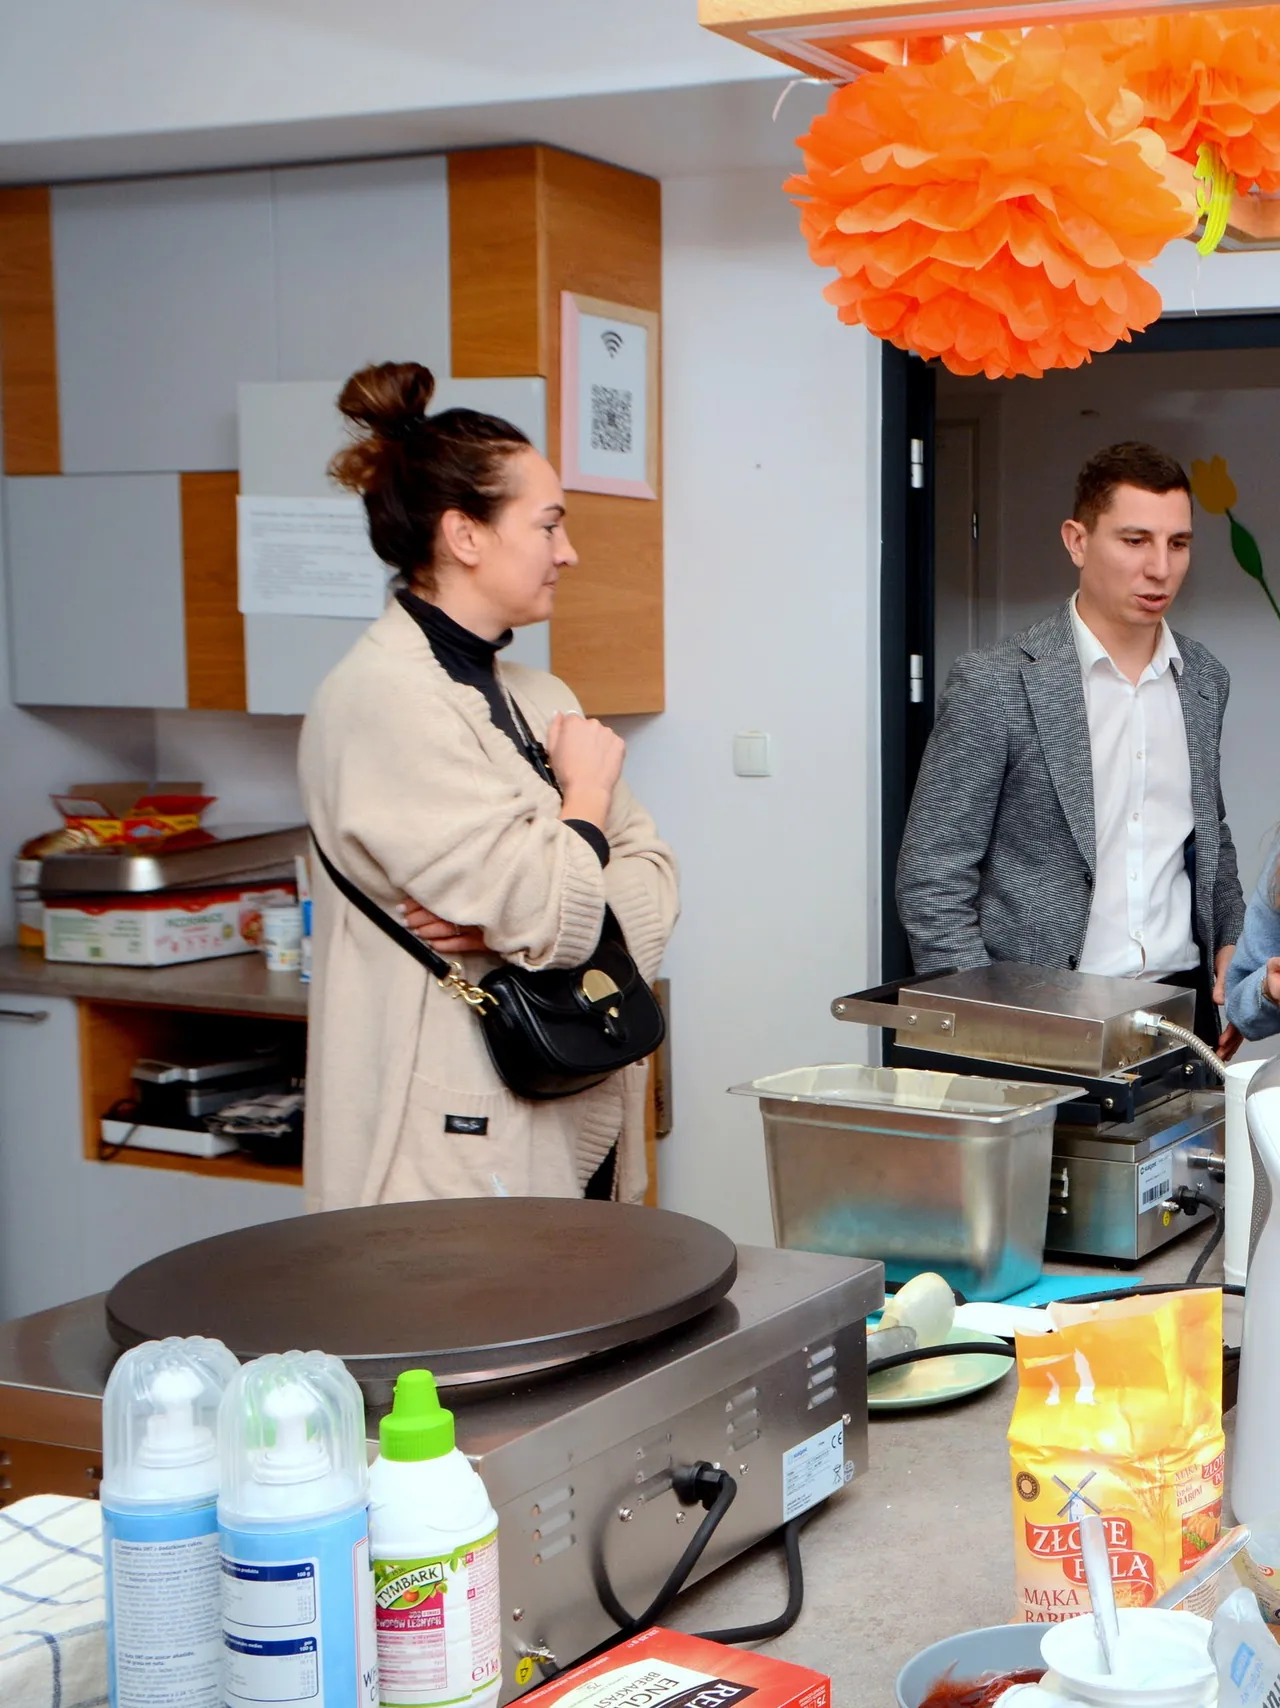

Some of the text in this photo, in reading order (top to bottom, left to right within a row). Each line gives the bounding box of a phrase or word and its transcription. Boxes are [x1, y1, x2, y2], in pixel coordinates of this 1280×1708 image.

[1074, 1554, 1150, 1580] PLA
[377, 1567, 438, 1604] TYMBARK
[1024, 1587, 1079, 1611] MĄKA
[618, 1677, 680, 1708] ENGL
[685, 1683, 743, 1708] RE
